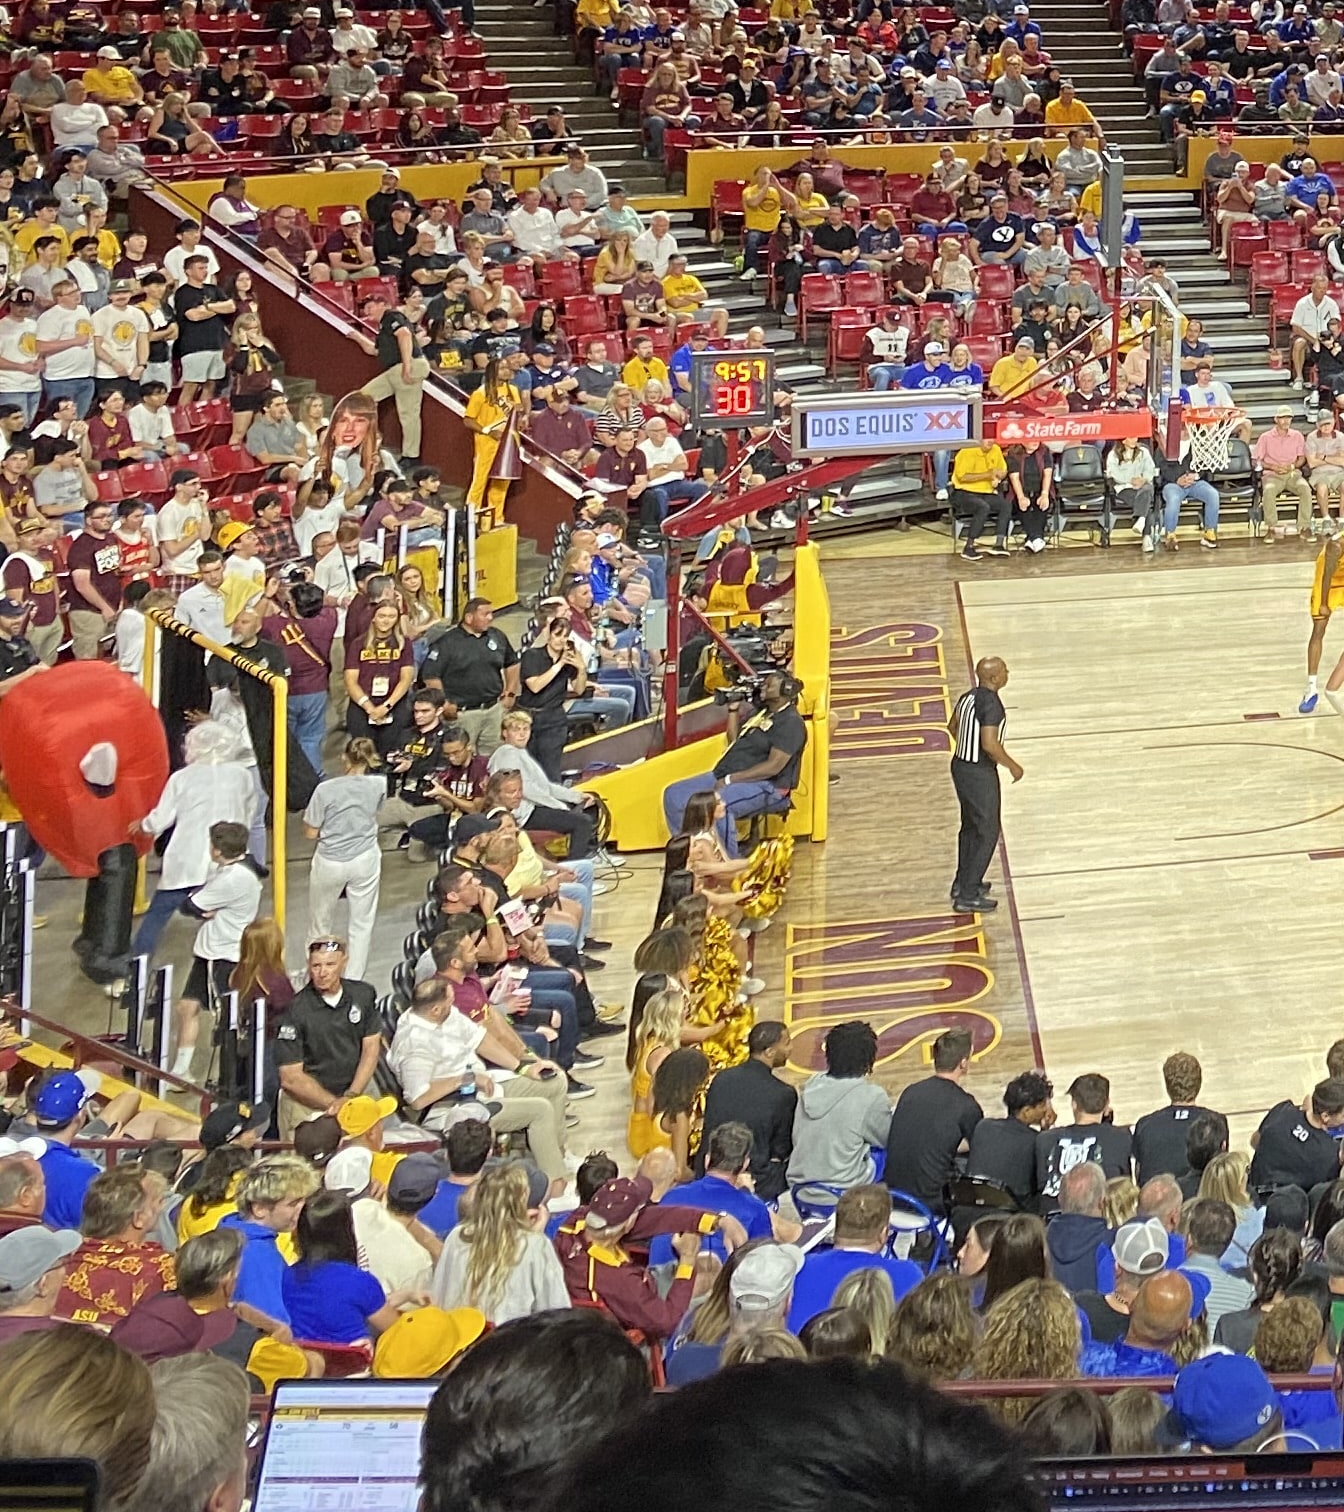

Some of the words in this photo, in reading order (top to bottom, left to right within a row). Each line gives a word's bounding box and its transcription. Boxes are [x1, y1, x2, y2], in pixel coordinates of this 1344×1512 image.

[714, 360, 766, 382] 9:57
[716, 386, 750, 414] 30
[812, 417, 849, 437] DOS
[856, 414, 914, 435] EQUIS
[924, 410, 964, 430] XX
[1174, 1110, 1189, 1119] 12
[1293, 1125, 1309, 1142] 20
[71, 1309, 99, 1322] ASU
